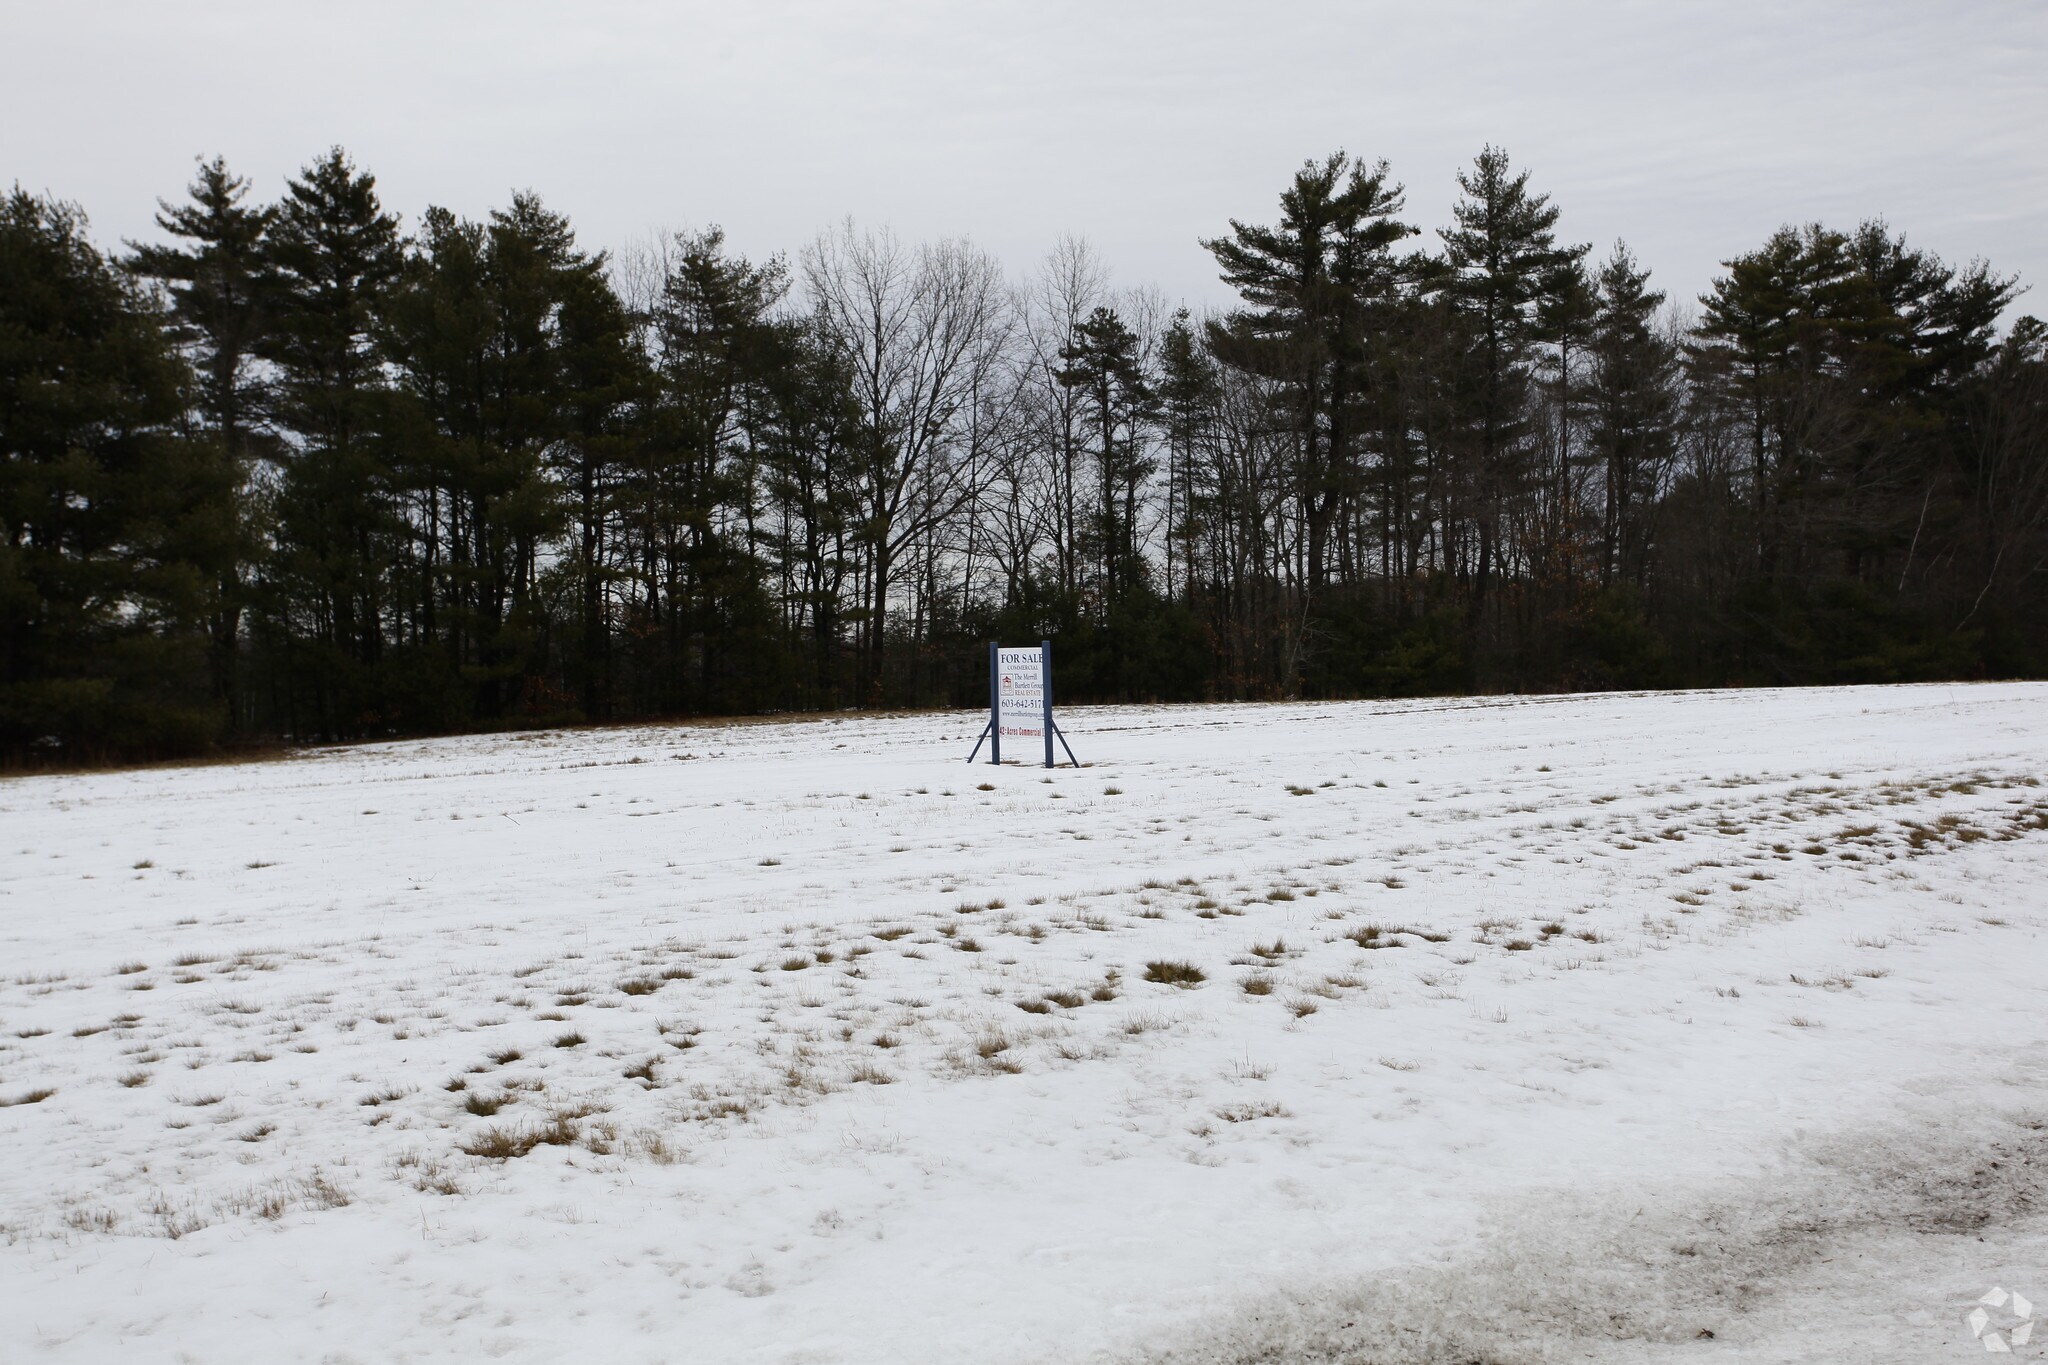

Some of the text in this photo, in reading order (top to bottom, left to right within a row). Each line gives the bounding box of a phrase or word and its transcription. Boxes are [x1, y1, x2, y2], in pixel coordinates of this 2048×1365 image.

[1001, 653, 1043, 663] FOR SALE
[1019, 727, 1041, 736] Commercial
